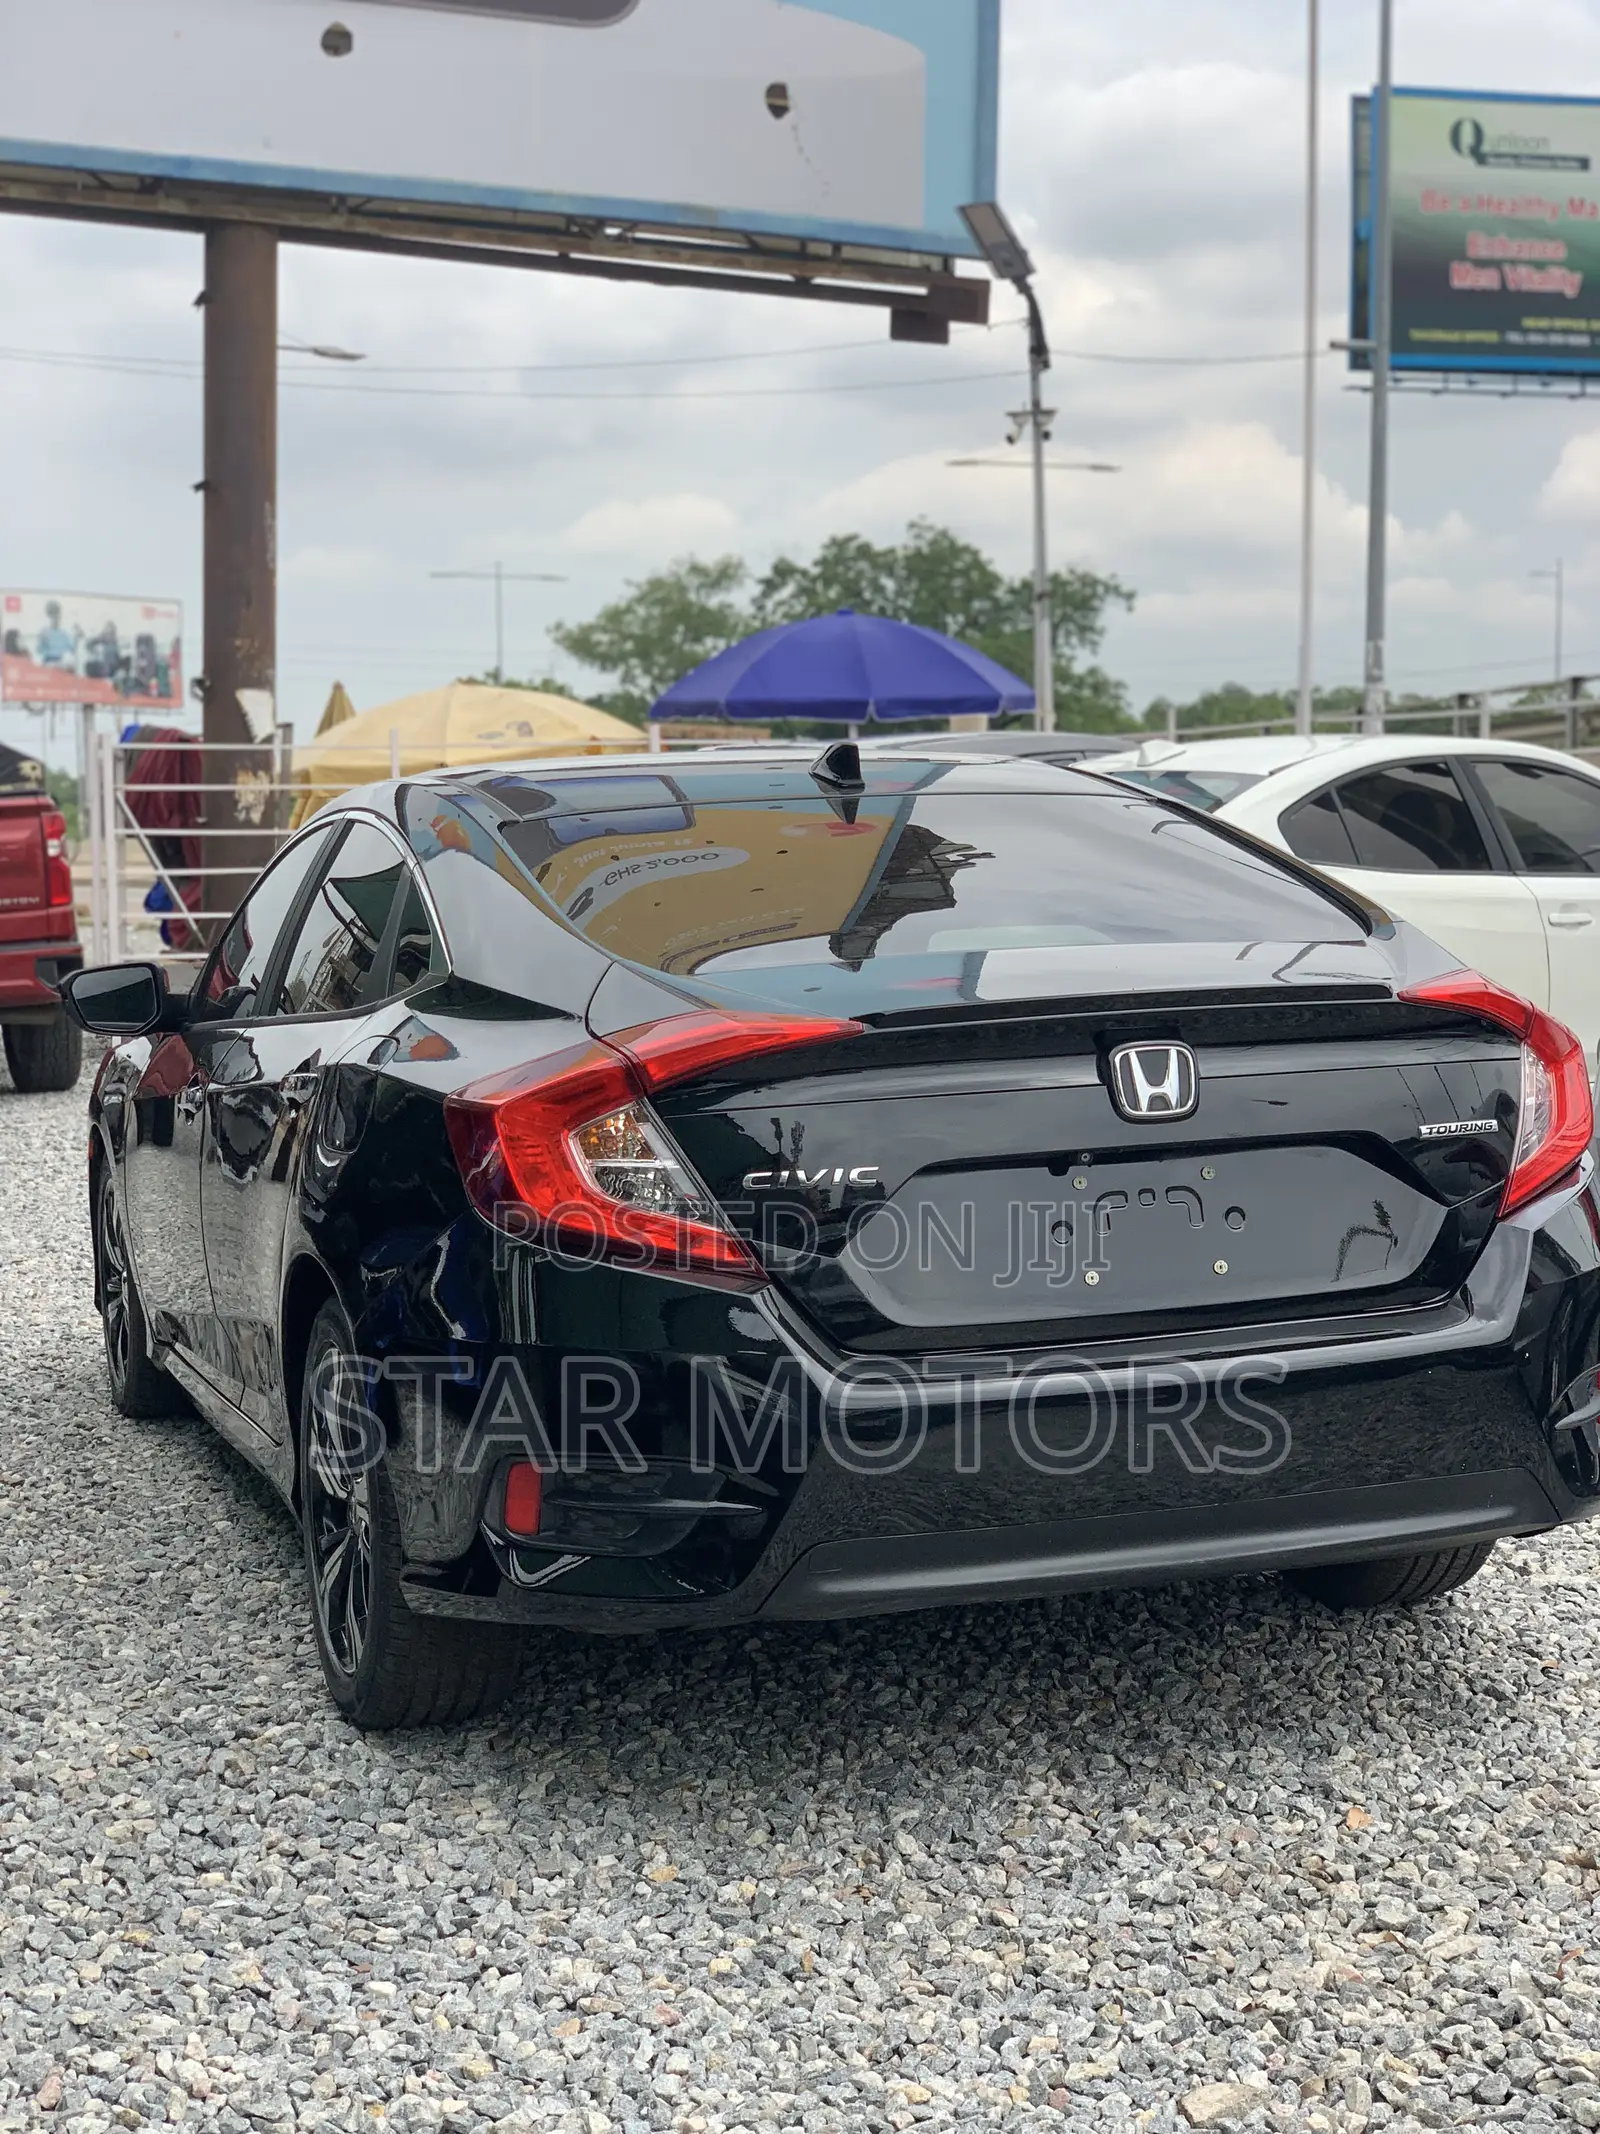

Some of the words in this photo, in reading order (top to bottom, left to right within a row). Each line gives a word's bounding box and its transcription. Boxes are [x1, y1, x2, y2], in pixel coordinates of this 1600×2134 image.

[1476, 194, 1560, 223] Healthy
[1425, 1121, 1494, 1136] TOURING
[742, 1166, 879, 1190] CIVIC
